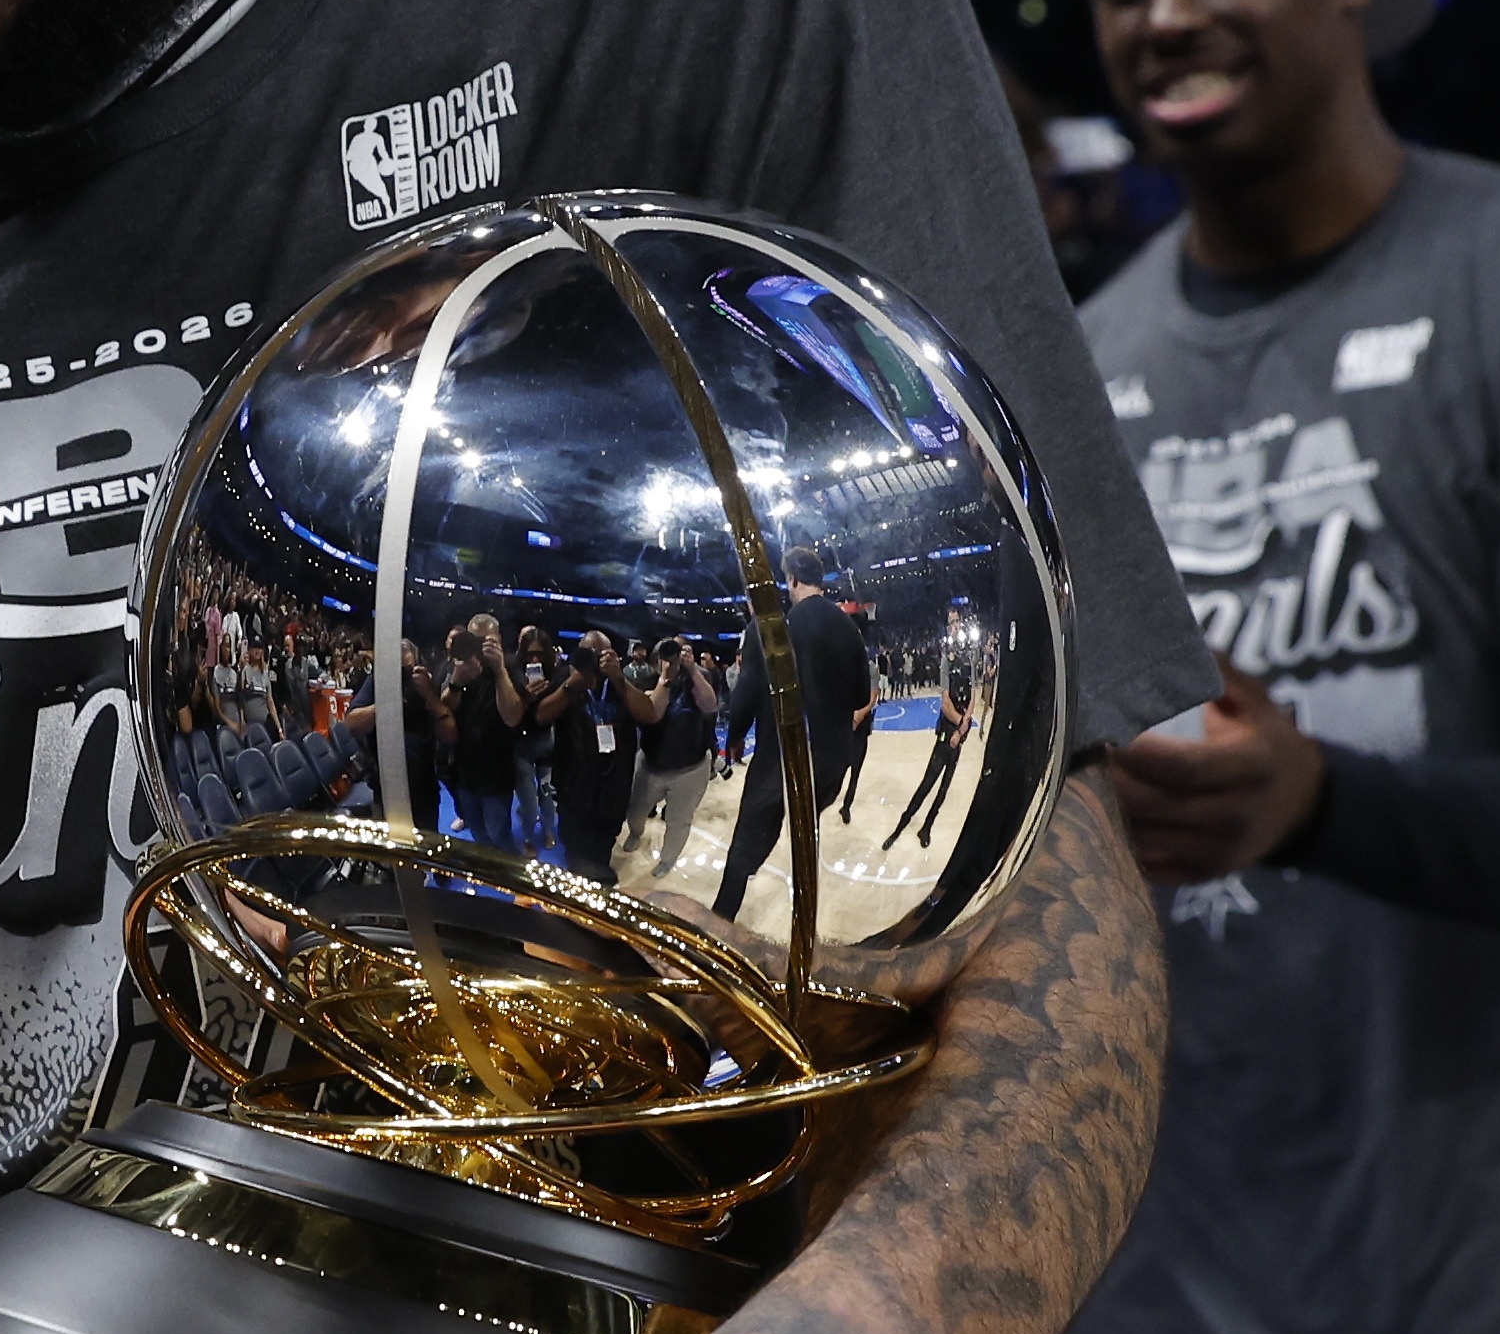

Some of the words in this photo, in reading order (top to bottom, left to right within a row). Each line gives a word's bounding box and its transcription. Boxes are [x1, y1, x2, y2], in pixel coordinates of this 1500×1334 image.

[412, 60, 518, 156] LOCKER
[355, 198, 383, 222] NBA
[418, 123, 501, 210] ROOM
